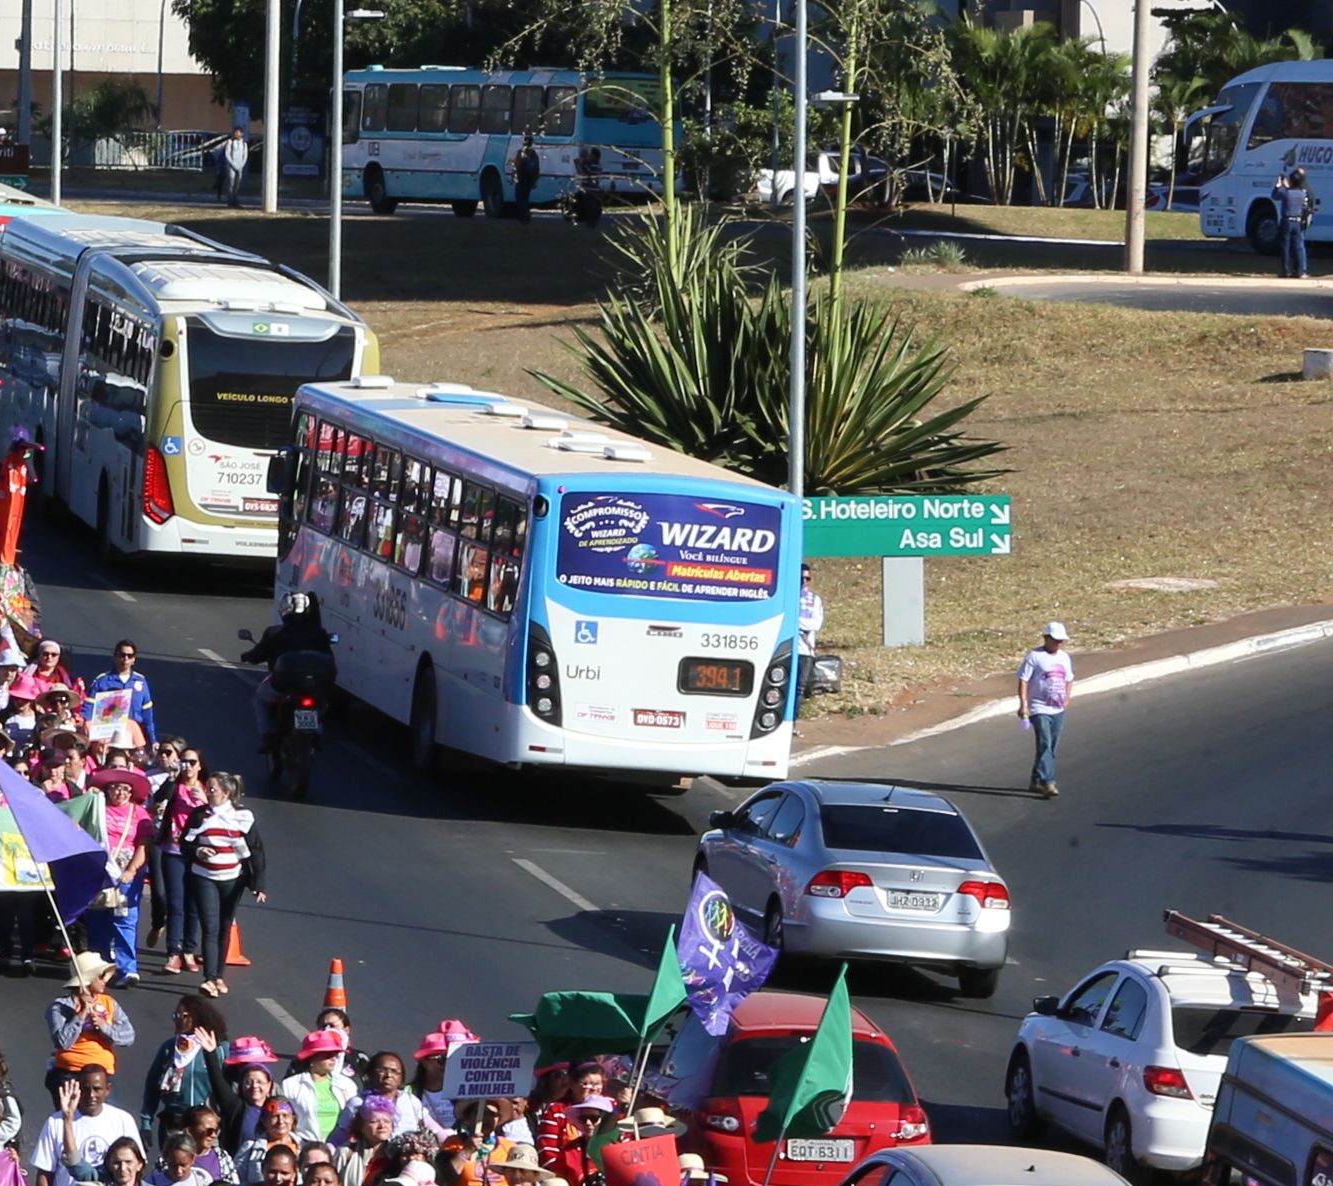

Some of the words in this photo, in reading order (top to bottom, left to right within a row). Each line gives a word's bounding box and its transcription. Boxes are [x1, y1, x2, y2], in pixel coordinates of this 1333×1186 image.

[216, 391, 256, 402] VEÍCULO
[257, 394, 289, 404] LONGO
[219, 460, 236, 470] SÃO
[239, 460, 262, 470] JOSÉ
[217, 472, 264, 485] 710237
[571, 506, 643, 525] COMPROMISSO
[923, 500, 985, 519] Norte
[590, 528, 626, 539] WIZARD
[656, 521, 776, 554] WIZARD
[899, 529, 941, 550] Asa
[949, 527, 984, 549] Sul
[671, 564, 724, 580] Matrículas
[725, 568, 766, 583] Abertas
[559, 574, 567, 583] O
[568, 575, 593, 586] JEITO
[594, 576, 615, 588] MAIS
[616, 576, 649, 590] RÁPIDO
[649, 580, 656, 590] E
[656, 579, 680, 592] FÁCIL
[682, 584, 693, 594] DE
[694, 584, 739, 597] APRENDER
[700, 633, 759, 650] 331856
[566, 664, 601, 681] Urbi
[465, 1044, 499, 1059] BASTA
[502, 1044, 521, 1058] DE
[460, 1055, 522, 1070] VIOLÊNCIA
[464, 1069, 513, 1083] CONTRA
[458, 1084, 467, 1097] A
[469, 1082, 516, 1097] MULHER
